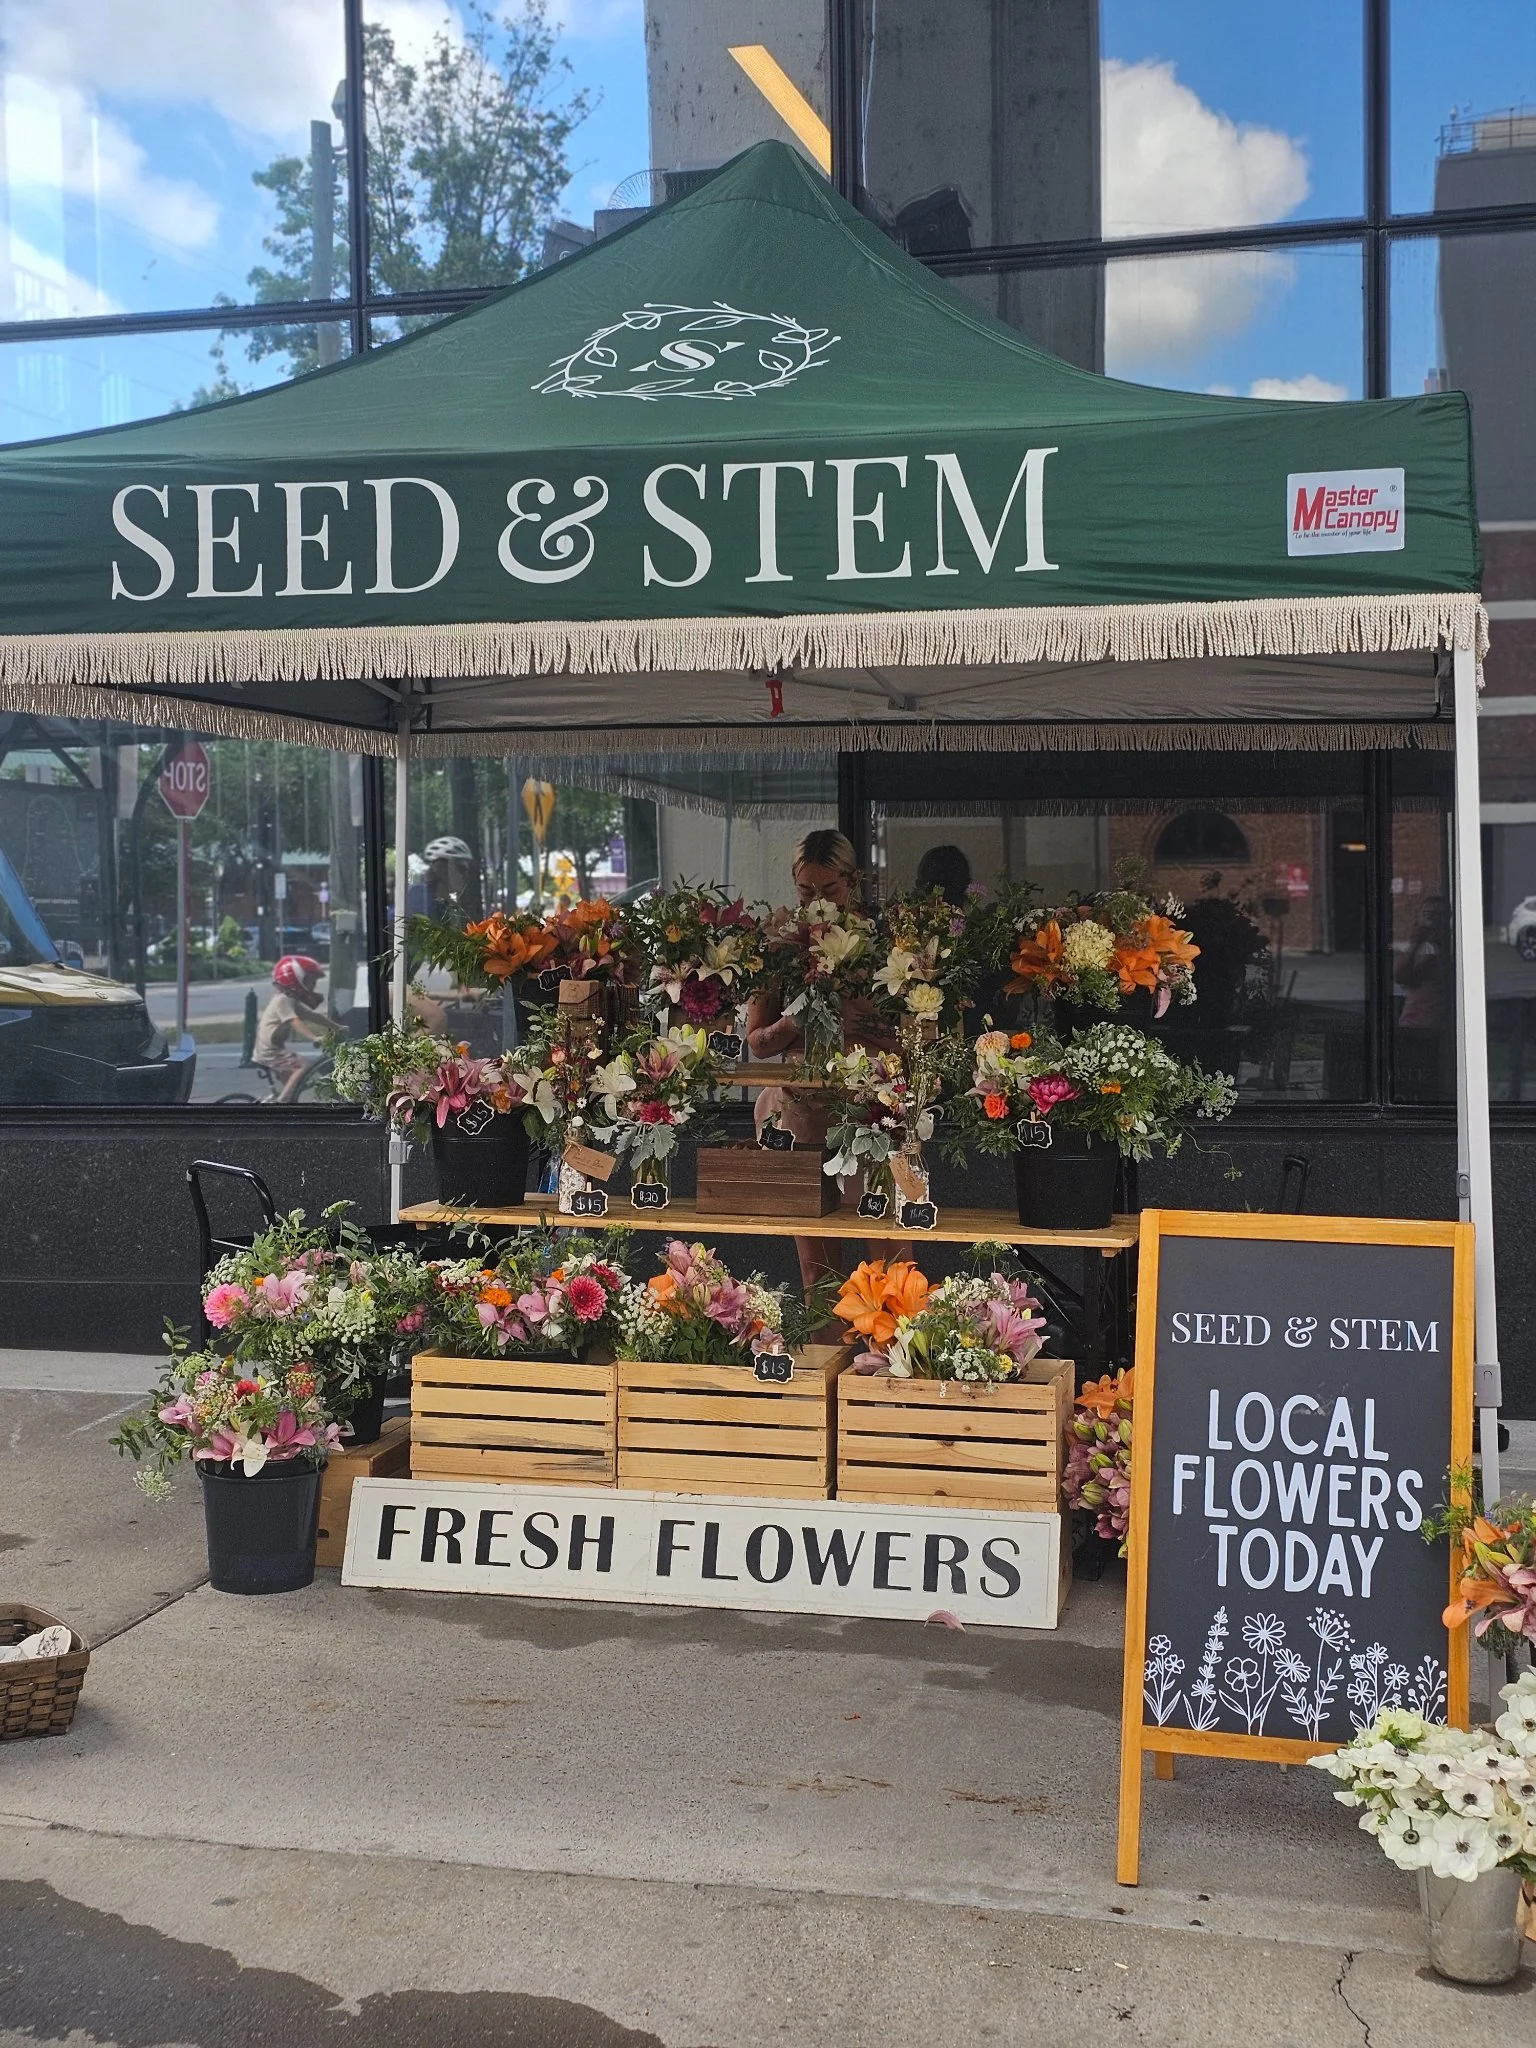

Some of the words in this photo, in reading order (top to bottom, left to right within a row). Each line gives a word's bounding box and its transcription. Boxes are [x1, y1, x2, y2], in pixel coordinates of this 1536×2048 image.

[111, 477, 460, 601] SEED
[498, 475, 609, 584] &
[643, 446, 1060, 588] STEM
[1293, 485, 1379, 532] Master
[1325, 508, 1399, 534] Canopy
[465, 1104, 489, 1130] $15
[575, 1196, 602, 1213] $15
[639, 1190, 659, 1204] $20
[1171, 1312, 1271, 1346] SEED
[1285, 1316, 1318, 1348] &
[1330, 1317, 1440, 1353] STEM
[761, 1360, 786, 1375] $15
[1208, 1389, 1390, 1462] LOCAL
[1172, 1453, 1424, 1532] FLOWERS
[376, 1504, 615, 1573] FRESH
[655, 1519, 1021, 1599] FLOWERS
[1208, 1524, 1384, 1598] TODAY
